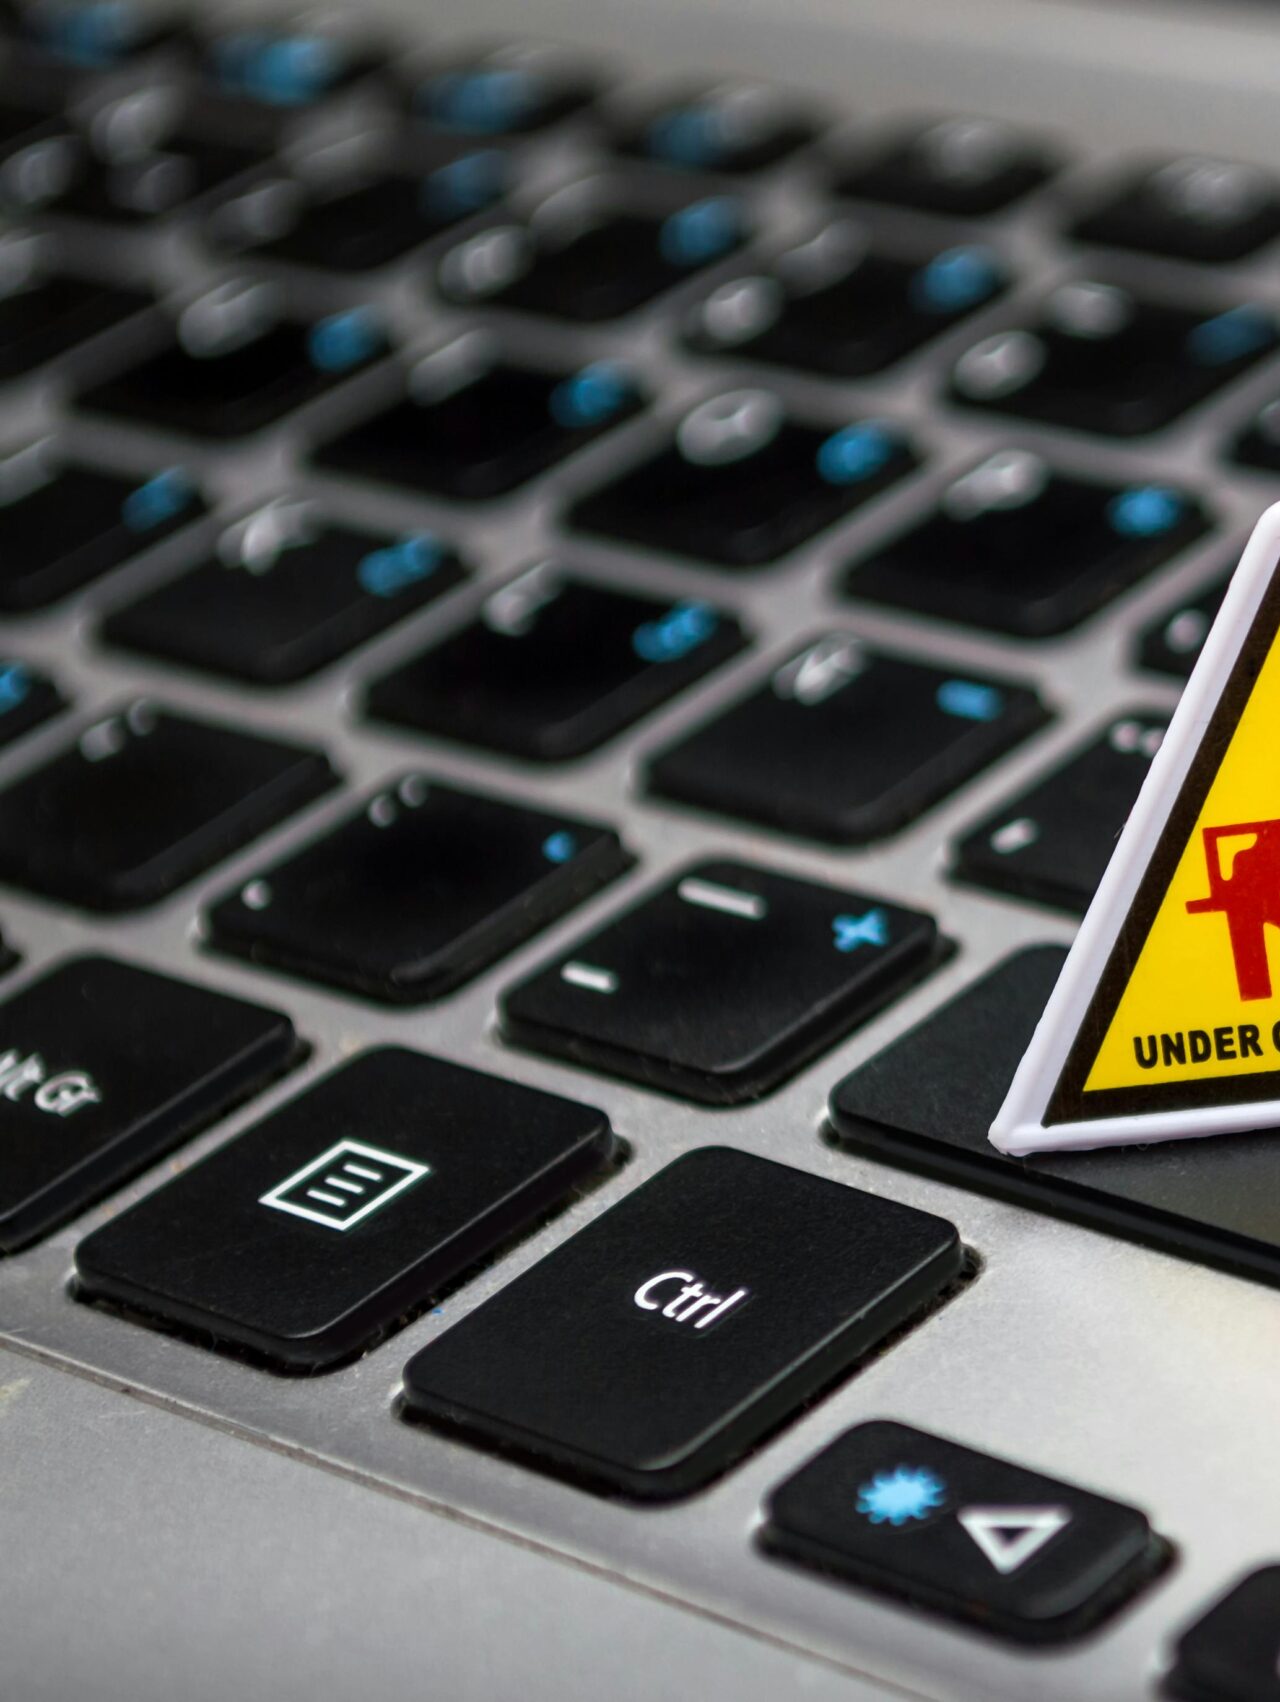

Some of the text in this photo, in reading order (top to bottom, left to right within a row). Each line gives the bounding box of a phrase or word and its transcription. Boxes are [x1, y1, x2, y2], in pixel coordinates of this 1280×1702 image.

[1133, 1024, 1264, 1069] UNDER
[0, 1049, 101, 1117] lt Gr
[633, 1270, 748, 1329] Ctrl
